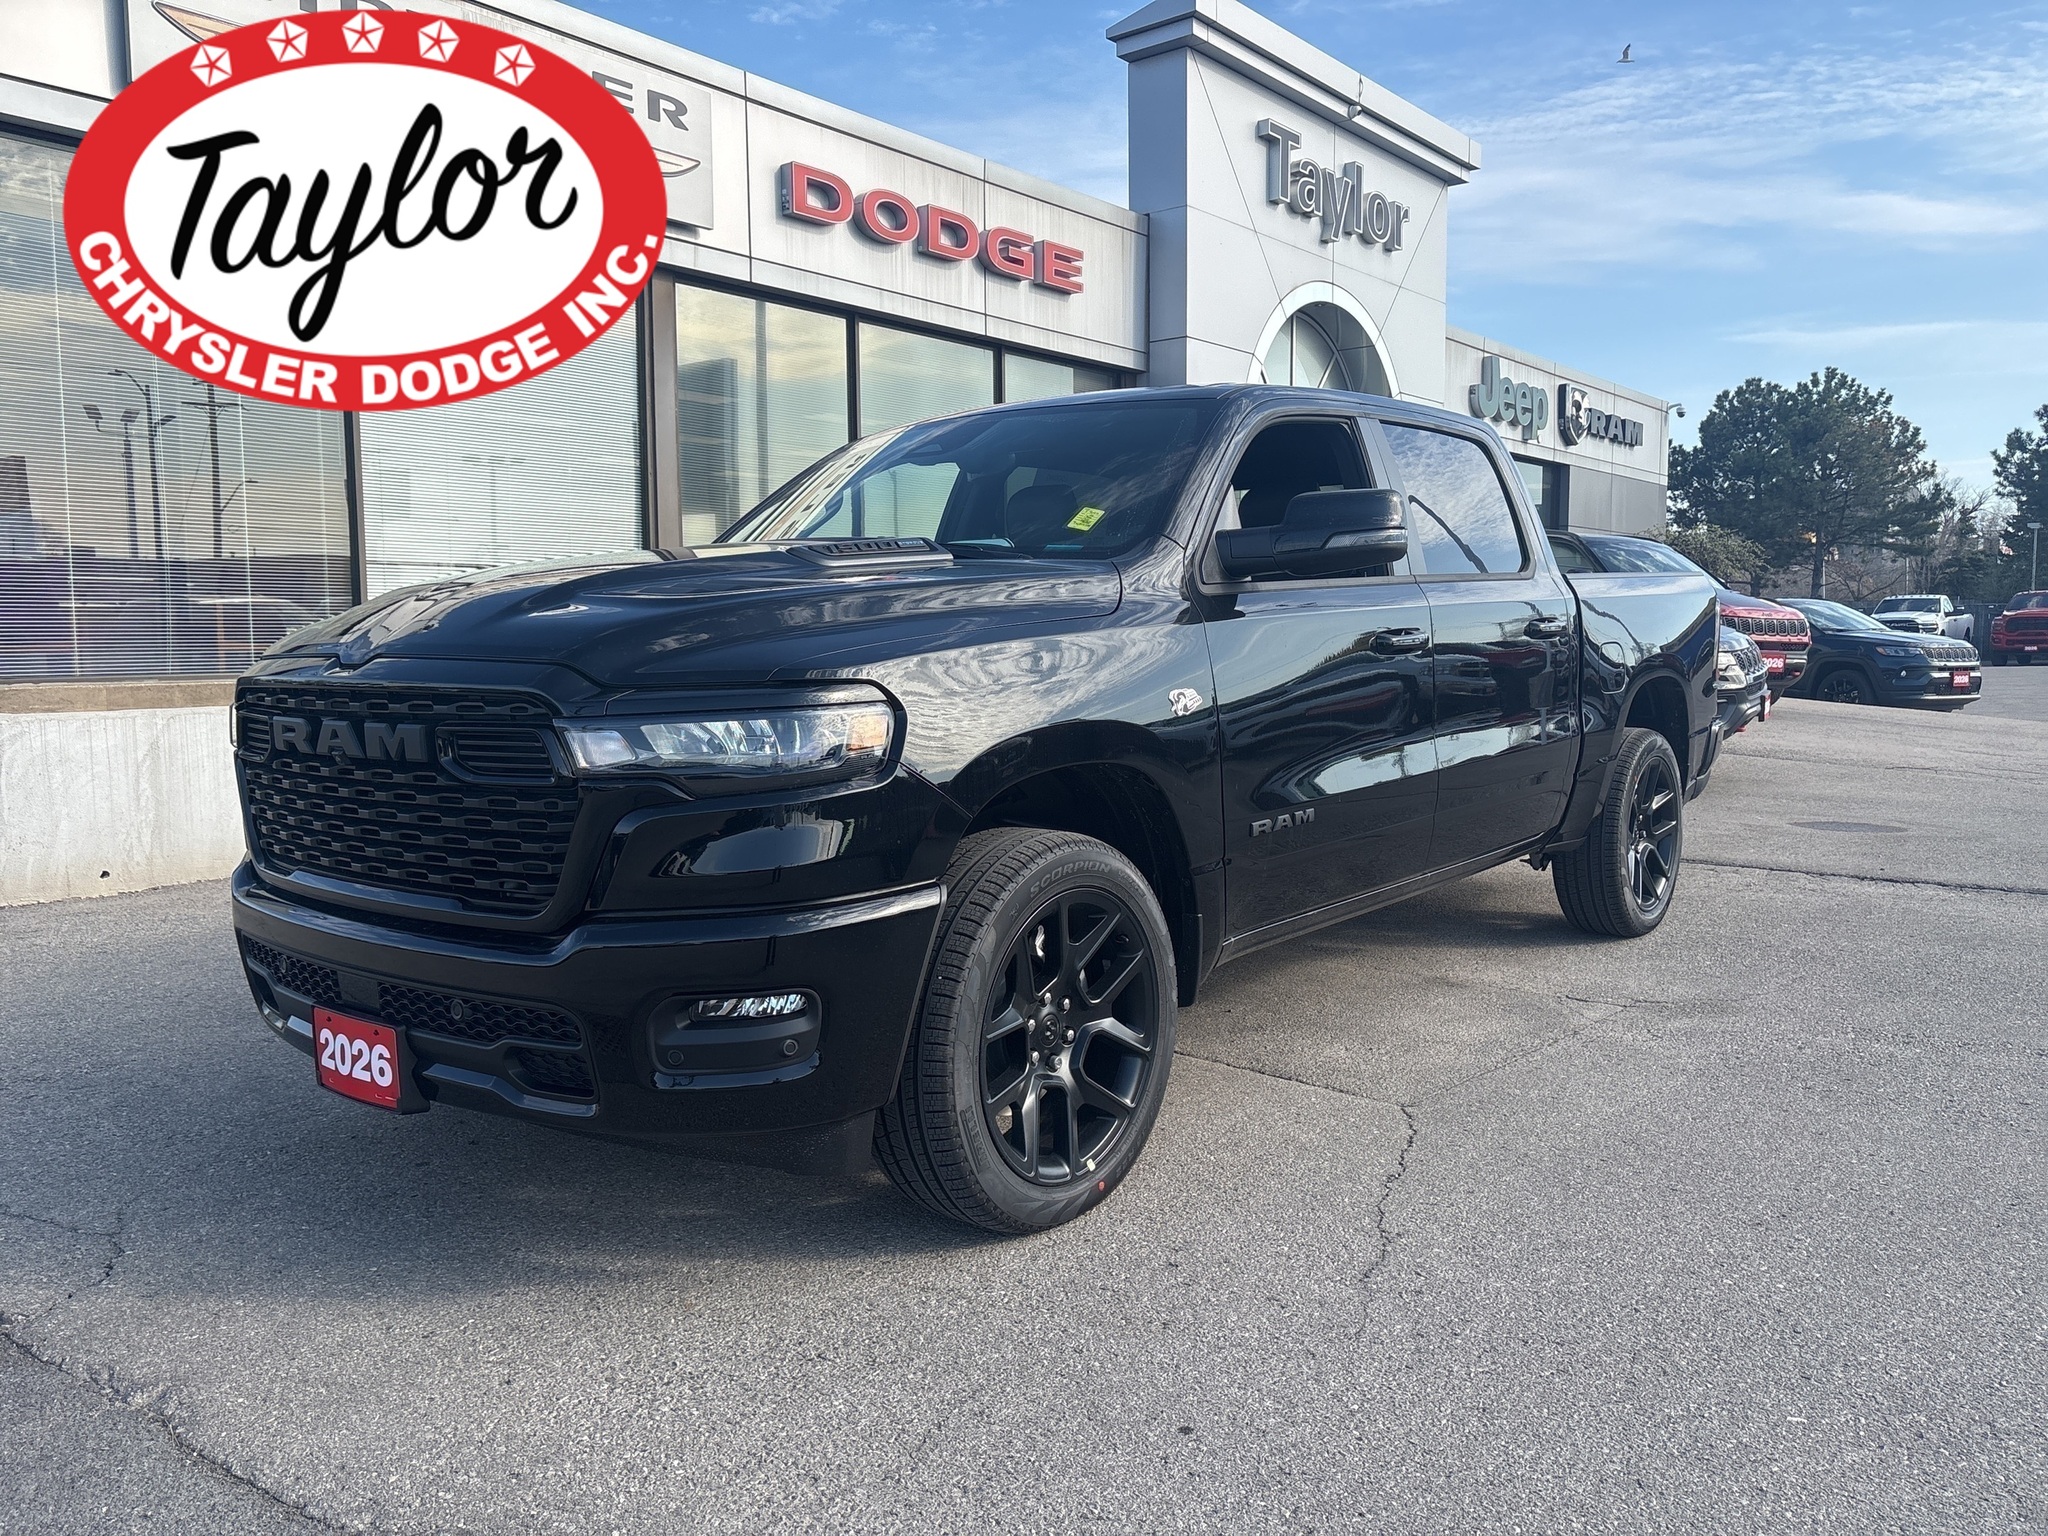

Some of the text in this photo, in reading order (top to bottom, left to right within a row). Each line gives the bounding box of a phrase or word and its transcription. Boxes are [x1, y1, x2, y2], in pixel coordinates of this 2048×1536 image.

[1257, 118, 1411, 252] Taylor
[781, 160, 1084, 294] DODGE
[1469, 356, 1549, 440] Jeep
[1588, 407, 1644, 447] RAM
[272, 715, 430, 763] RAM
[1250, 807, 1315, 837] RAM
[1029, 860, 1112, 899] SCORPION
[319, 1027, 393, 1088] 2026
